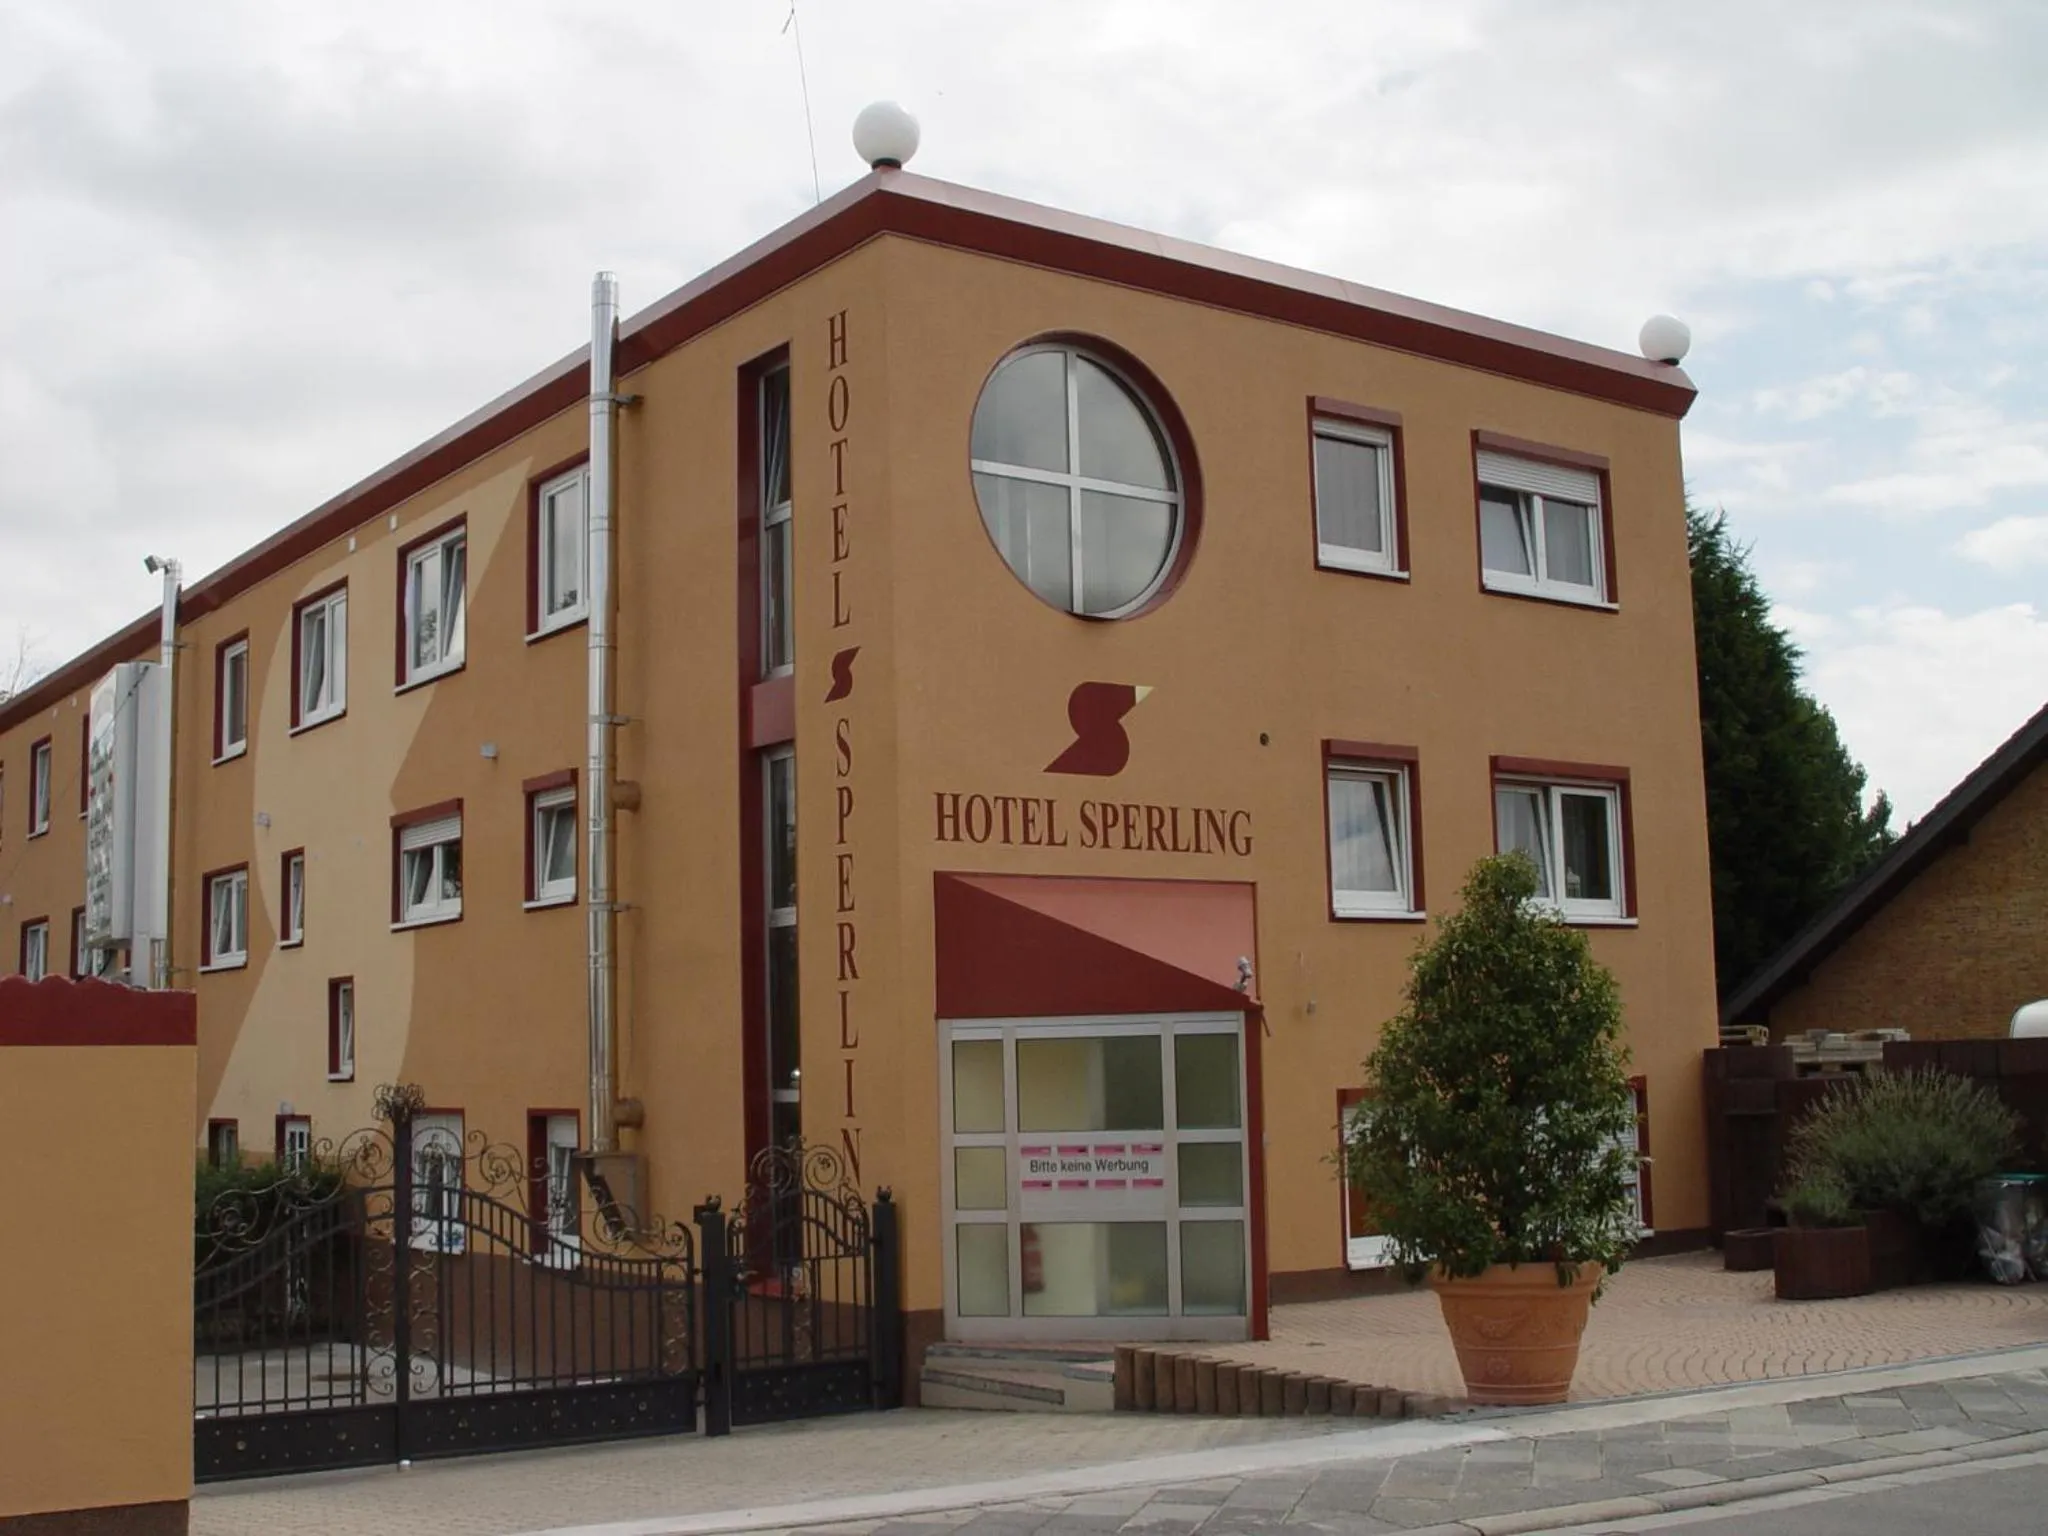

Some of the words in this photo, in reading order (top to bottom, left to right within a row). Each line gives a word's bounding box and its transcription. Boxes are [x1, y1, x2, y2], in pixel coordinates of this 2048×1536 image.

[827, 309, 851, 628] HOTEL
[934, 792, 1068, 847] HOTEL
[1079, 799, 1254, 857] SPERLING
[836, 718, 862, 1195] SPERLIN
[1029, 1160, 1058, 1173] Bitte
[1060, 1159, 1092, 1173] keine
[1094, 1158, 1150, 1173] Werbung
